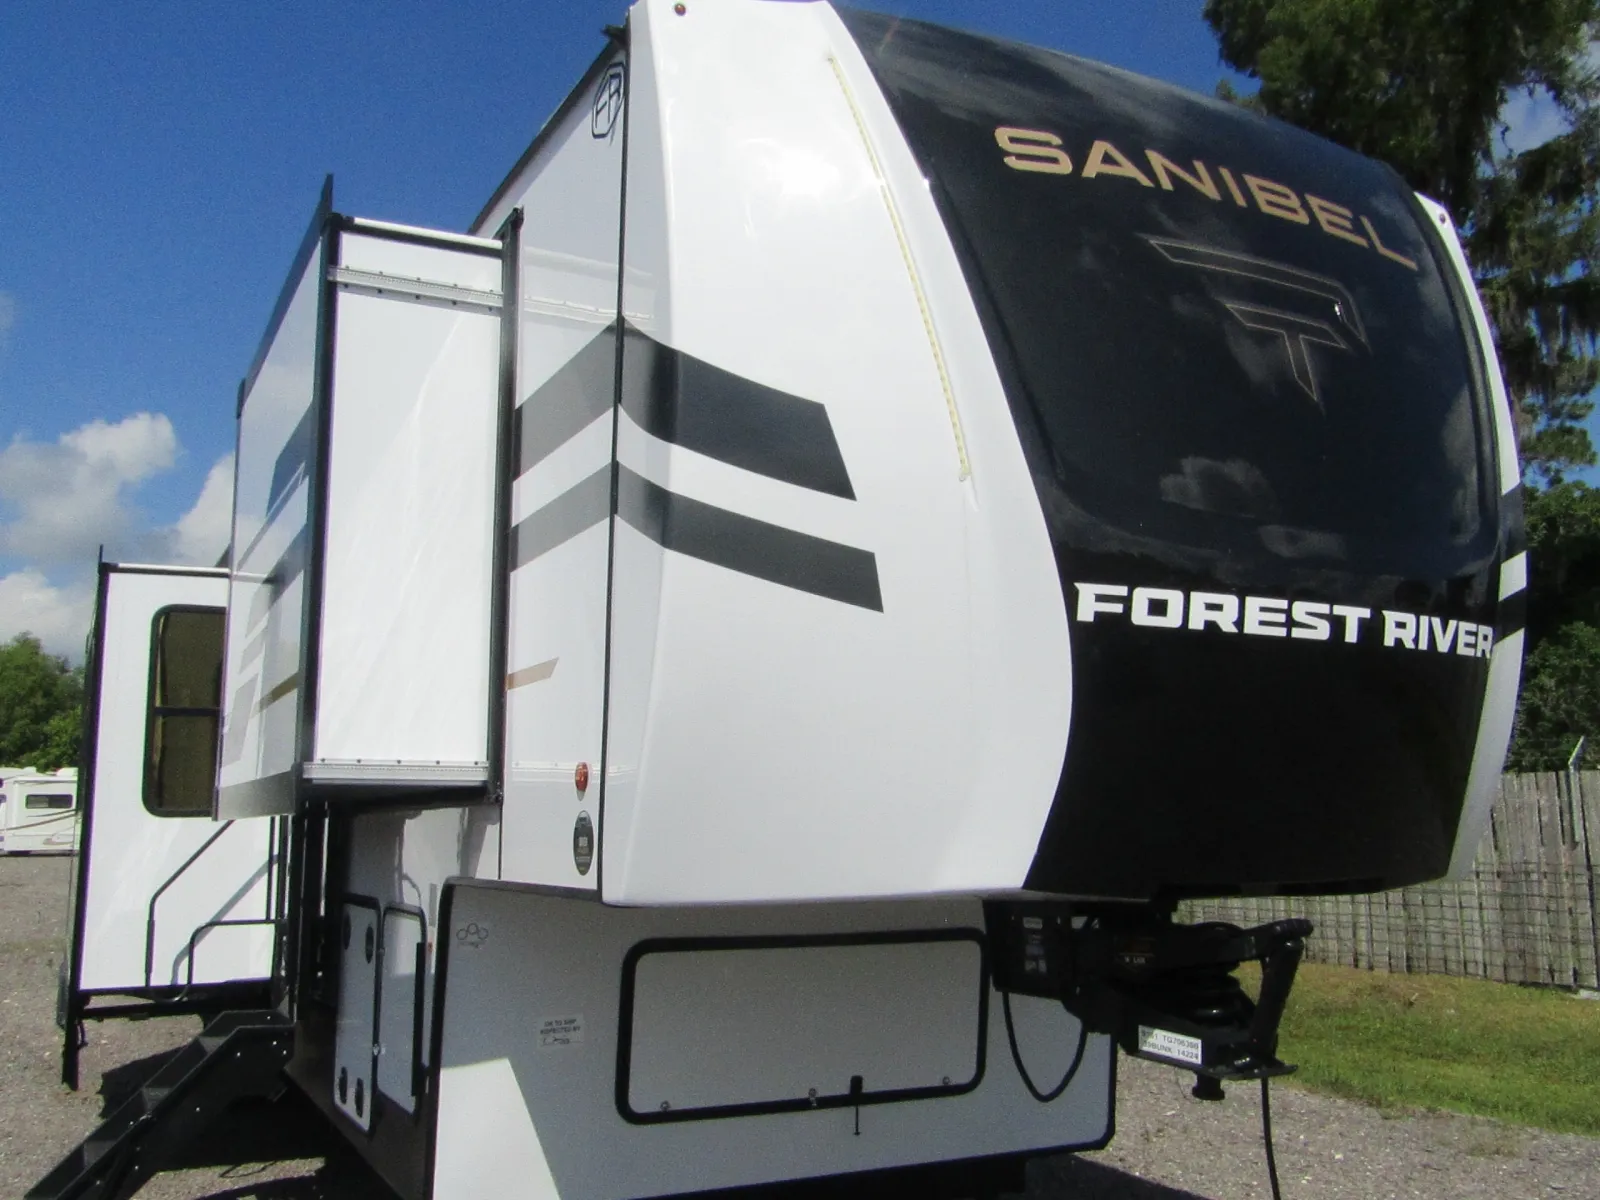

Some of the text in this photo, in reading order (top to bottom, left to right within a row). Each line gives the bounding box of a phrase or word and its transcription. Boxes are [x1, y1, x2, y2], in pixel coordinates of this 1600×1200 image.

[994, 126, 1417, 270] SANIBEL
[1073, 582, 1494, 658] FOREST RIVER
